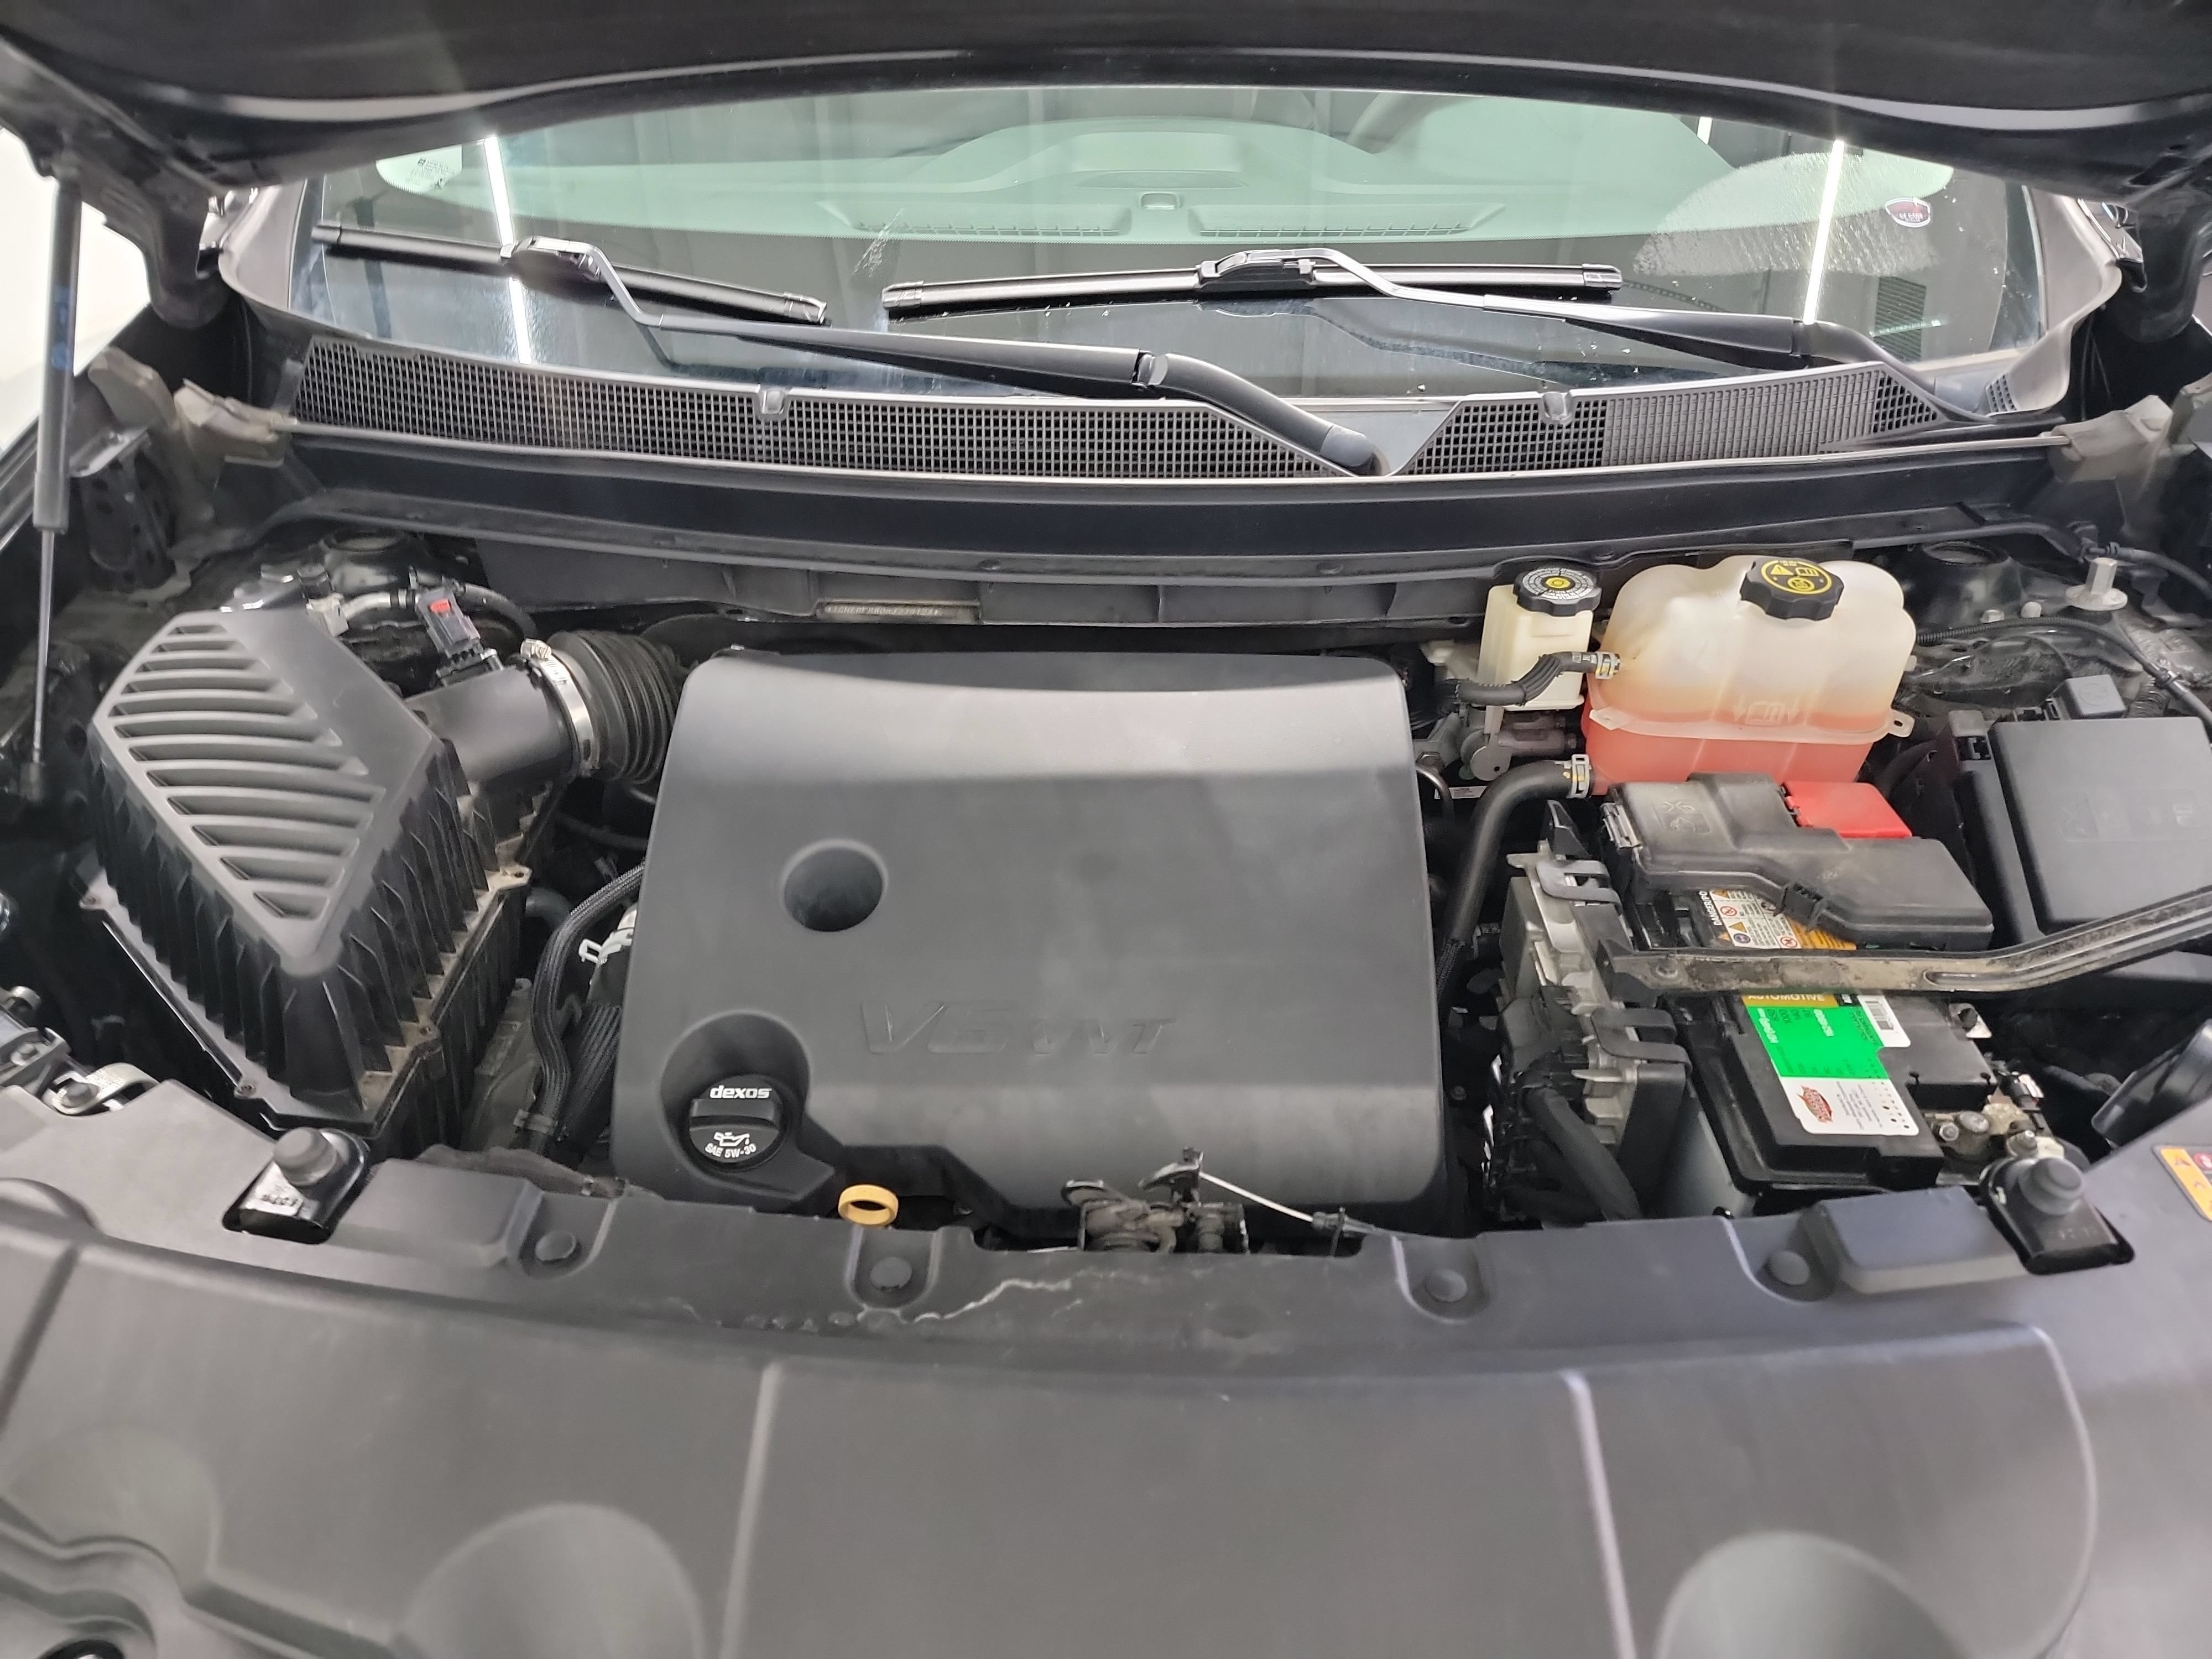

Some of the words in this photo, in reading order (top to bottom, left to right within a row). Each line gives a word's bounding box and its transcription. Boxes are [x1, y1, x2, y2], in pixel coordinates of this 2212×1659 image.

[860, 1001, 1018, 1055] V6
[1030, 1018, 1176, 1055] VVT
[709, 1085, 771, 1099] dexos
[705, 1143, 723, 1157] SAE
[724, 1143, 757, 1158] 5W-30
